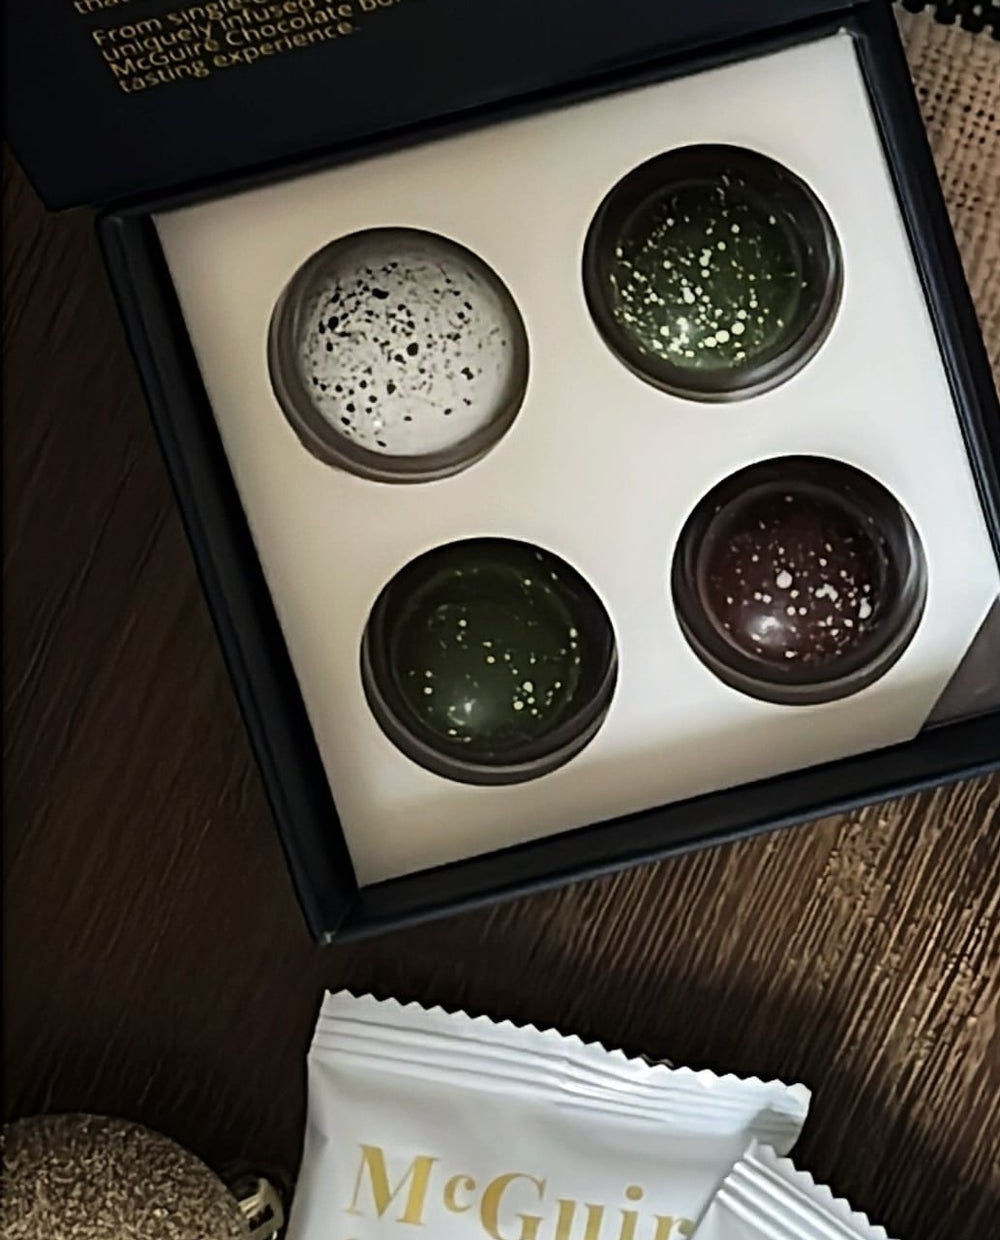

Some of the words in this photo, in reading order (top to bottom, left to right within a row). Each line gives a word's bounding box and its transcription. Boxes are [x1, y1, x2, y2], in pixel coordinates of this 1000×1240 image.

[92, 19, 162, 46] From
[102, 17, 212, 68] uniquely
[109, 36, 218, 77] McGuire
[225, 5, 352, 46] Chocolate
[119, 61, 210, 93] tasting
